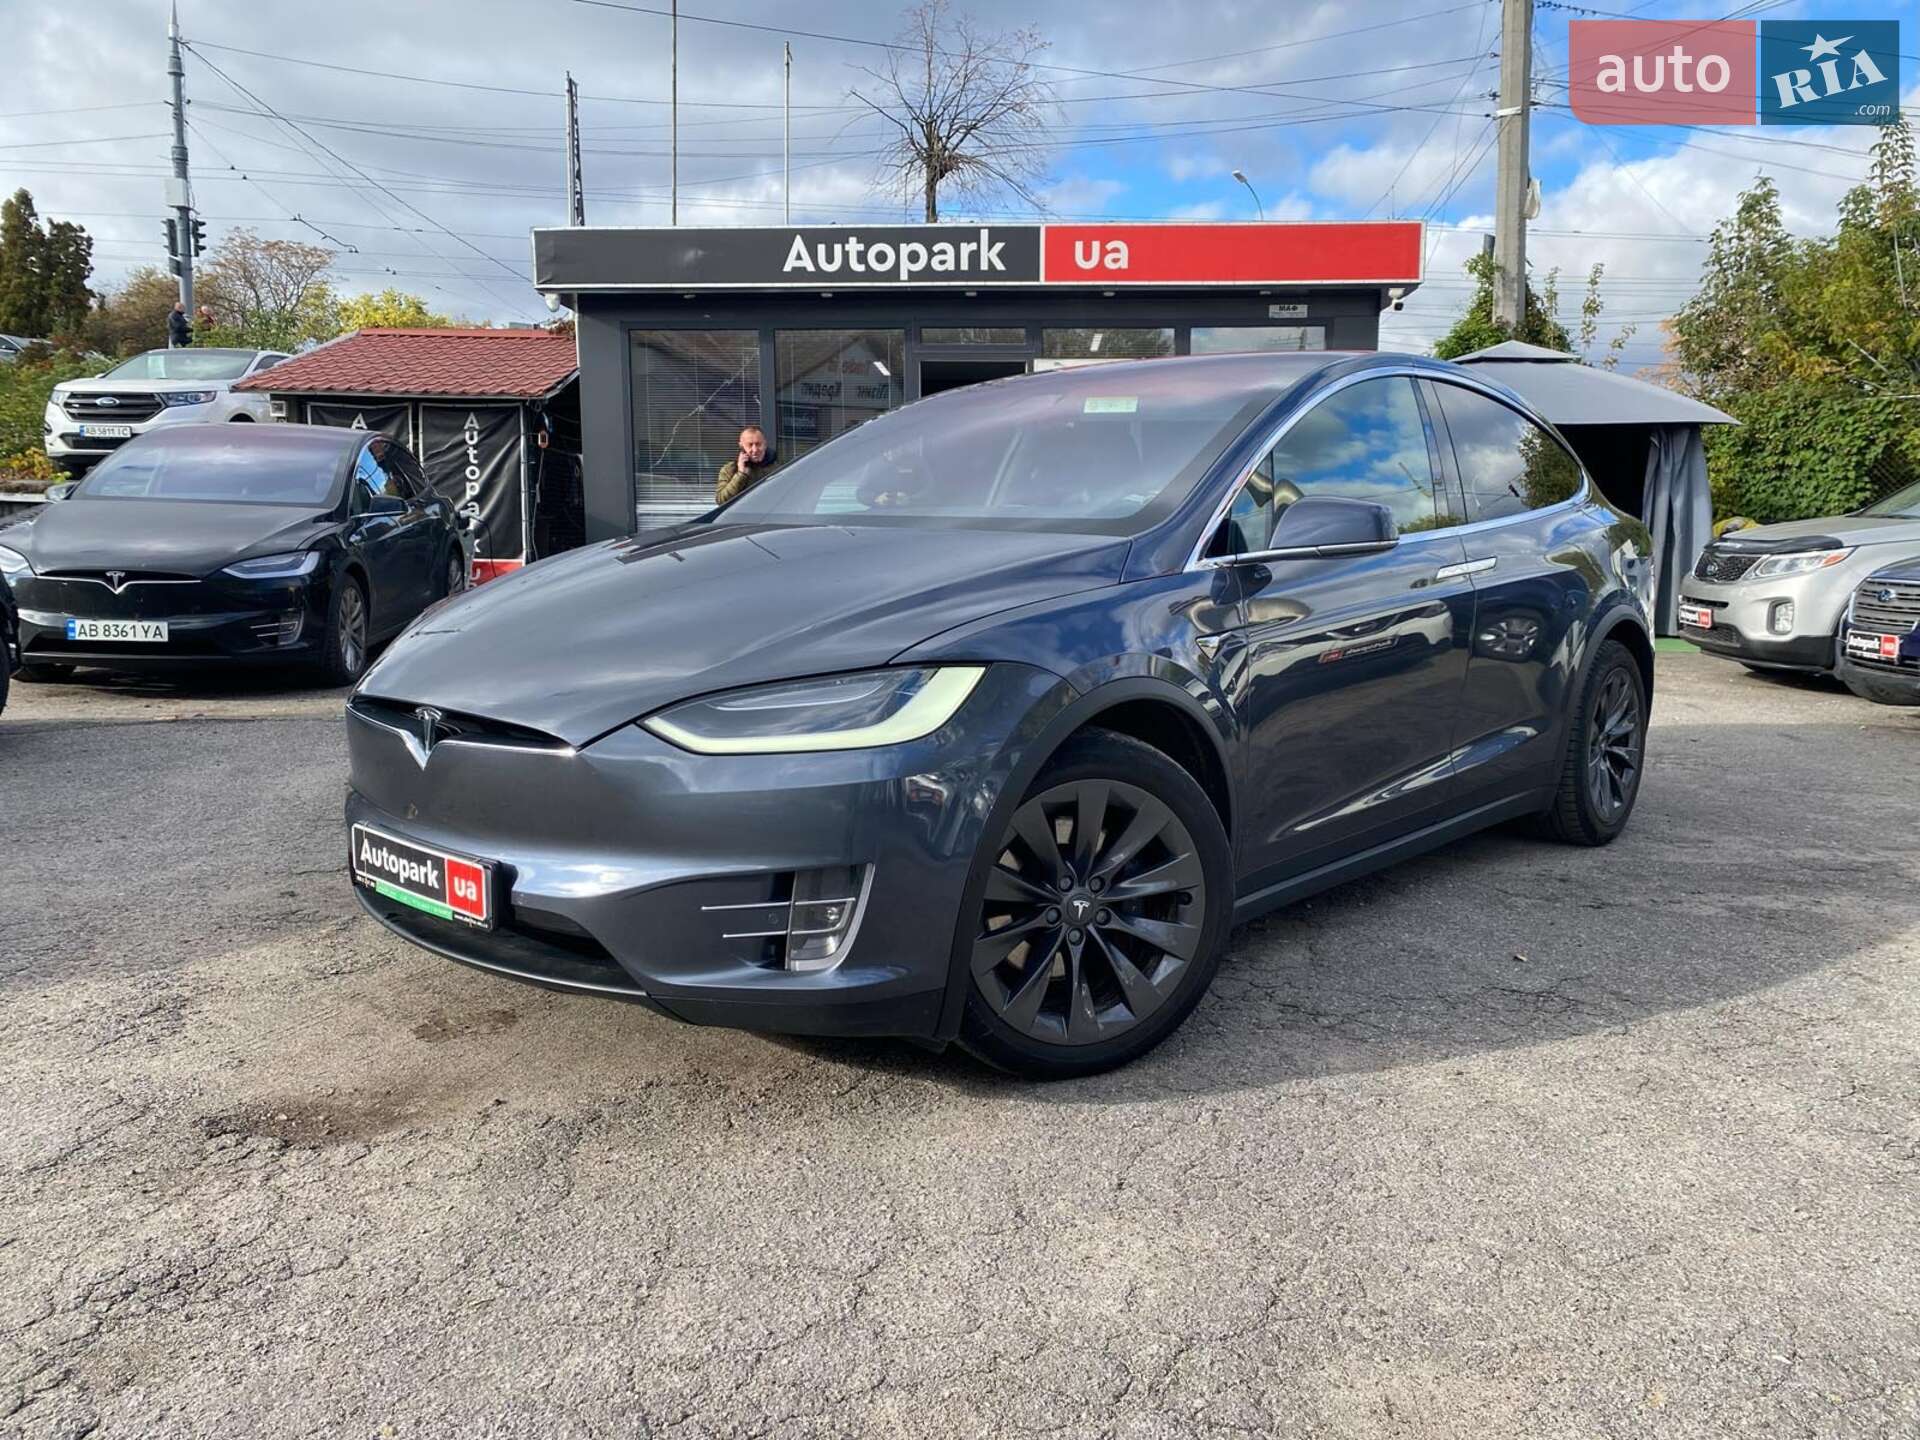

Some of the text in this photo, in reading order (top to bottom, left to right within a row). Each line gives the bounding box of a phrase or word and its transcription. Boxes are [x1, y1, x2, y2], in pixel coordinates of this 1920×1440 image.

[783, 228, 1129, 281] Autopark ua
[77, 623, 164, 639] AB 8361 YA
[360, 838, 440, 890] Autopark
[453, 876, 478, 902] ua
